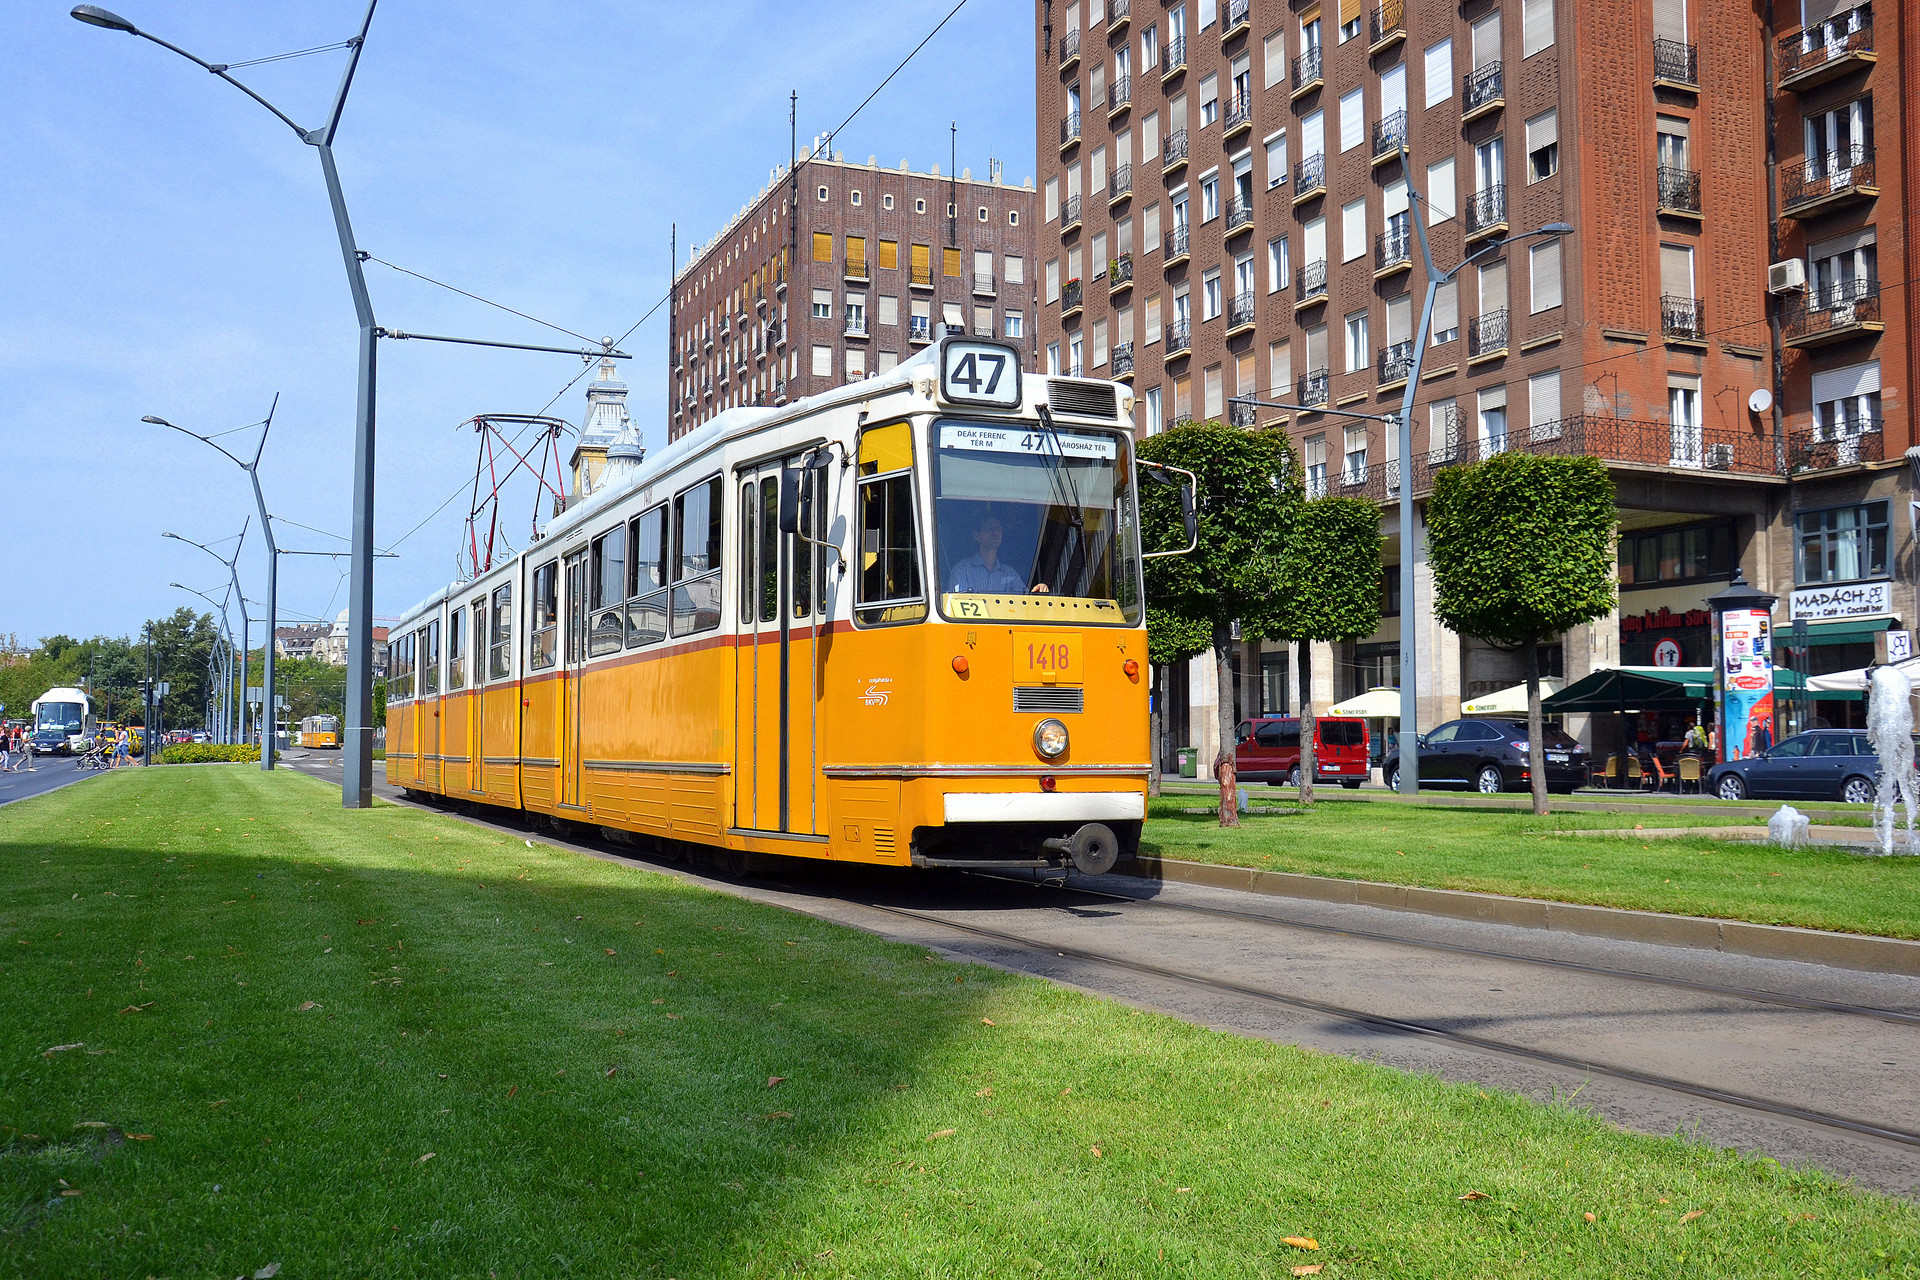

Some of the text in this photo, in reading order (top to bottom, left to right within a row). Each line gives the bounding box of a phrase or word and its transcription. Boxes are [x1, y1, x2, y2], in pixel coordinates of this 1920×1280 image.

[950, 352, 1006, 395] 47
[957, 429, 1007, 440] DEÁK FERENC
[970, 439, 985, 447] TÉR
[1020, 433, 1045, 451] 47
[1094, 443, 1107, 452] TÉR
[1794, 588, 1865, 608] MADÁCH
[960, 602, 982, 616] F2
[1822, 607, 1838, 616] Café
[1871, 604, 1883, 612] bar
[1027, 643, 1069, 670] 1418
